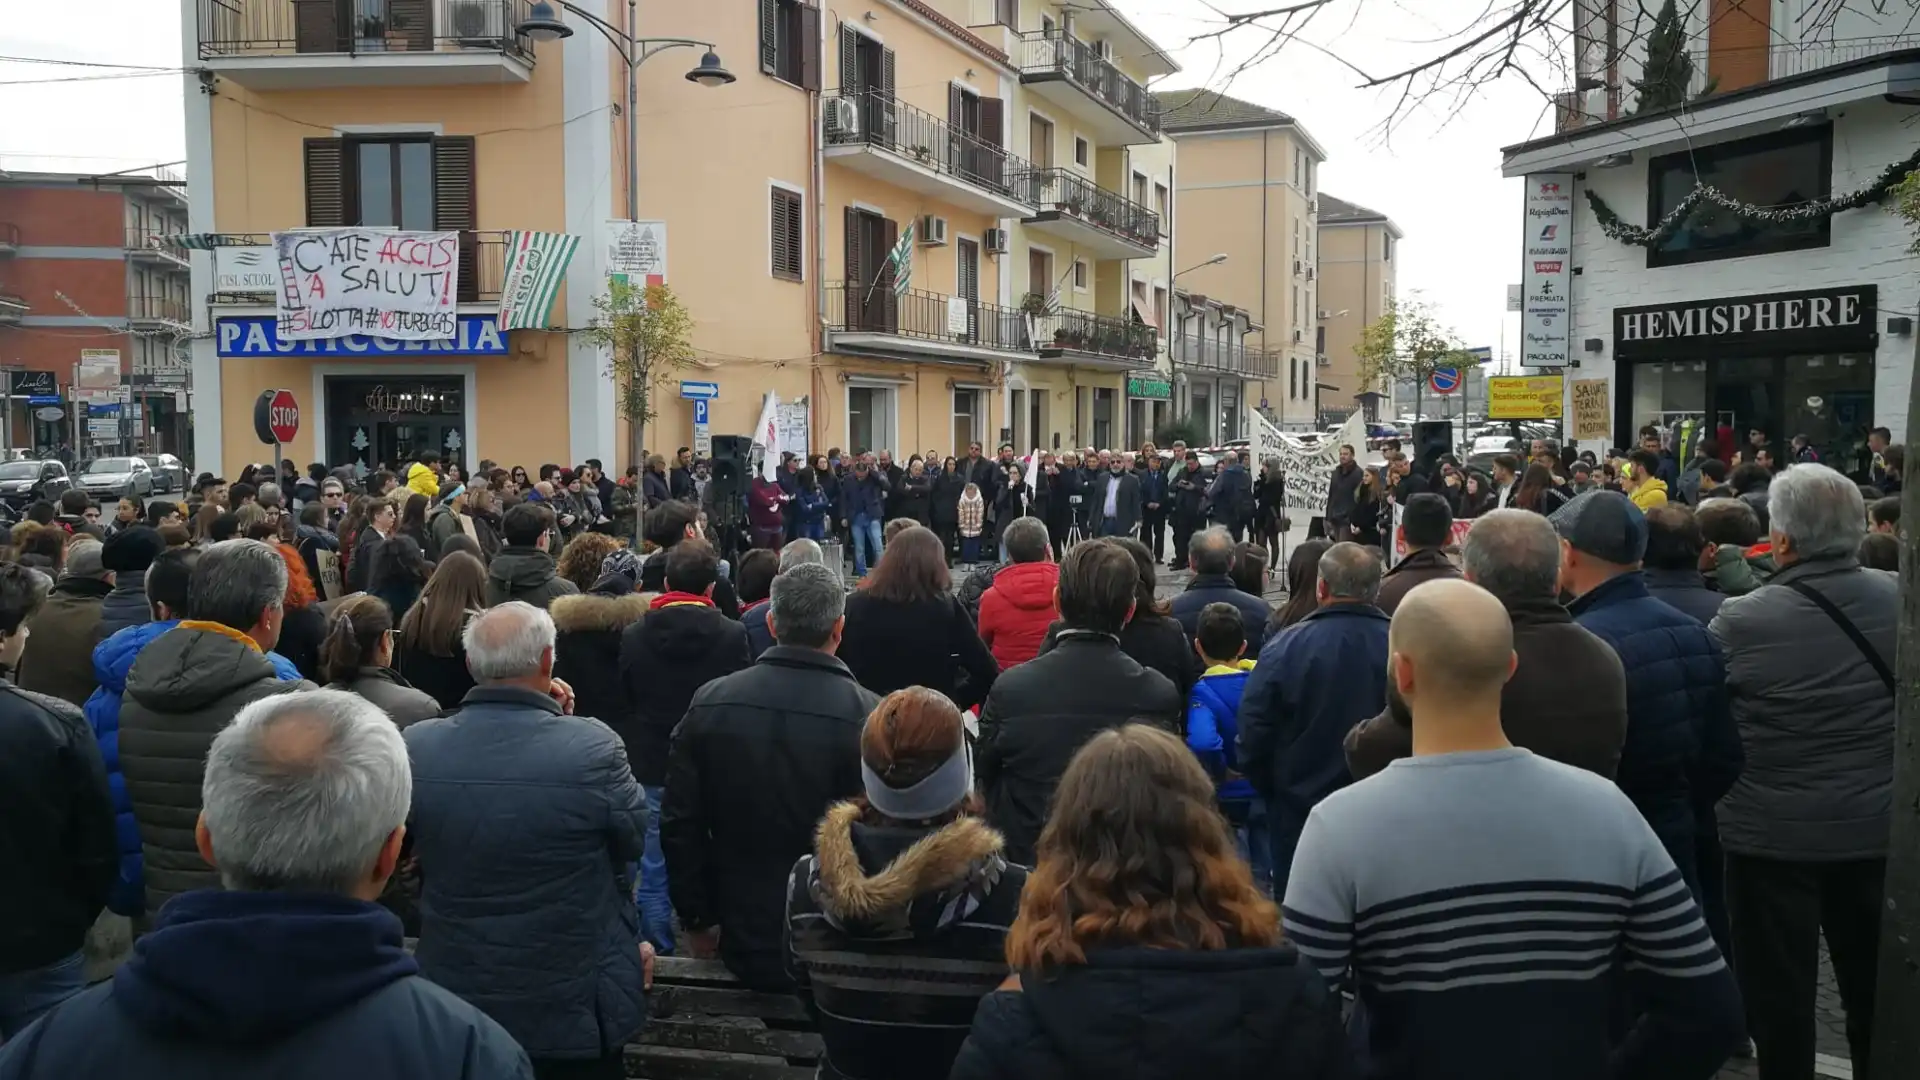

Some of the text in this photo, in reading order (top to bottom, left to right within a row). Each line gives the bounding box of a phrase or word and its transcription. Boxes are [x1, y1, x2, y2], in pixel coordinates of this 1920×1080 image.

[243, 273, 275, 286] SCUOL
[514, 274, 532, 309] CISL
[1622, 294, 1861, 340] HEMISPHERE
[1527, 353, 1565, 361] PAOLONI
[272, 406, 298, 426] STOP
[697, 401, 706, 421] P
